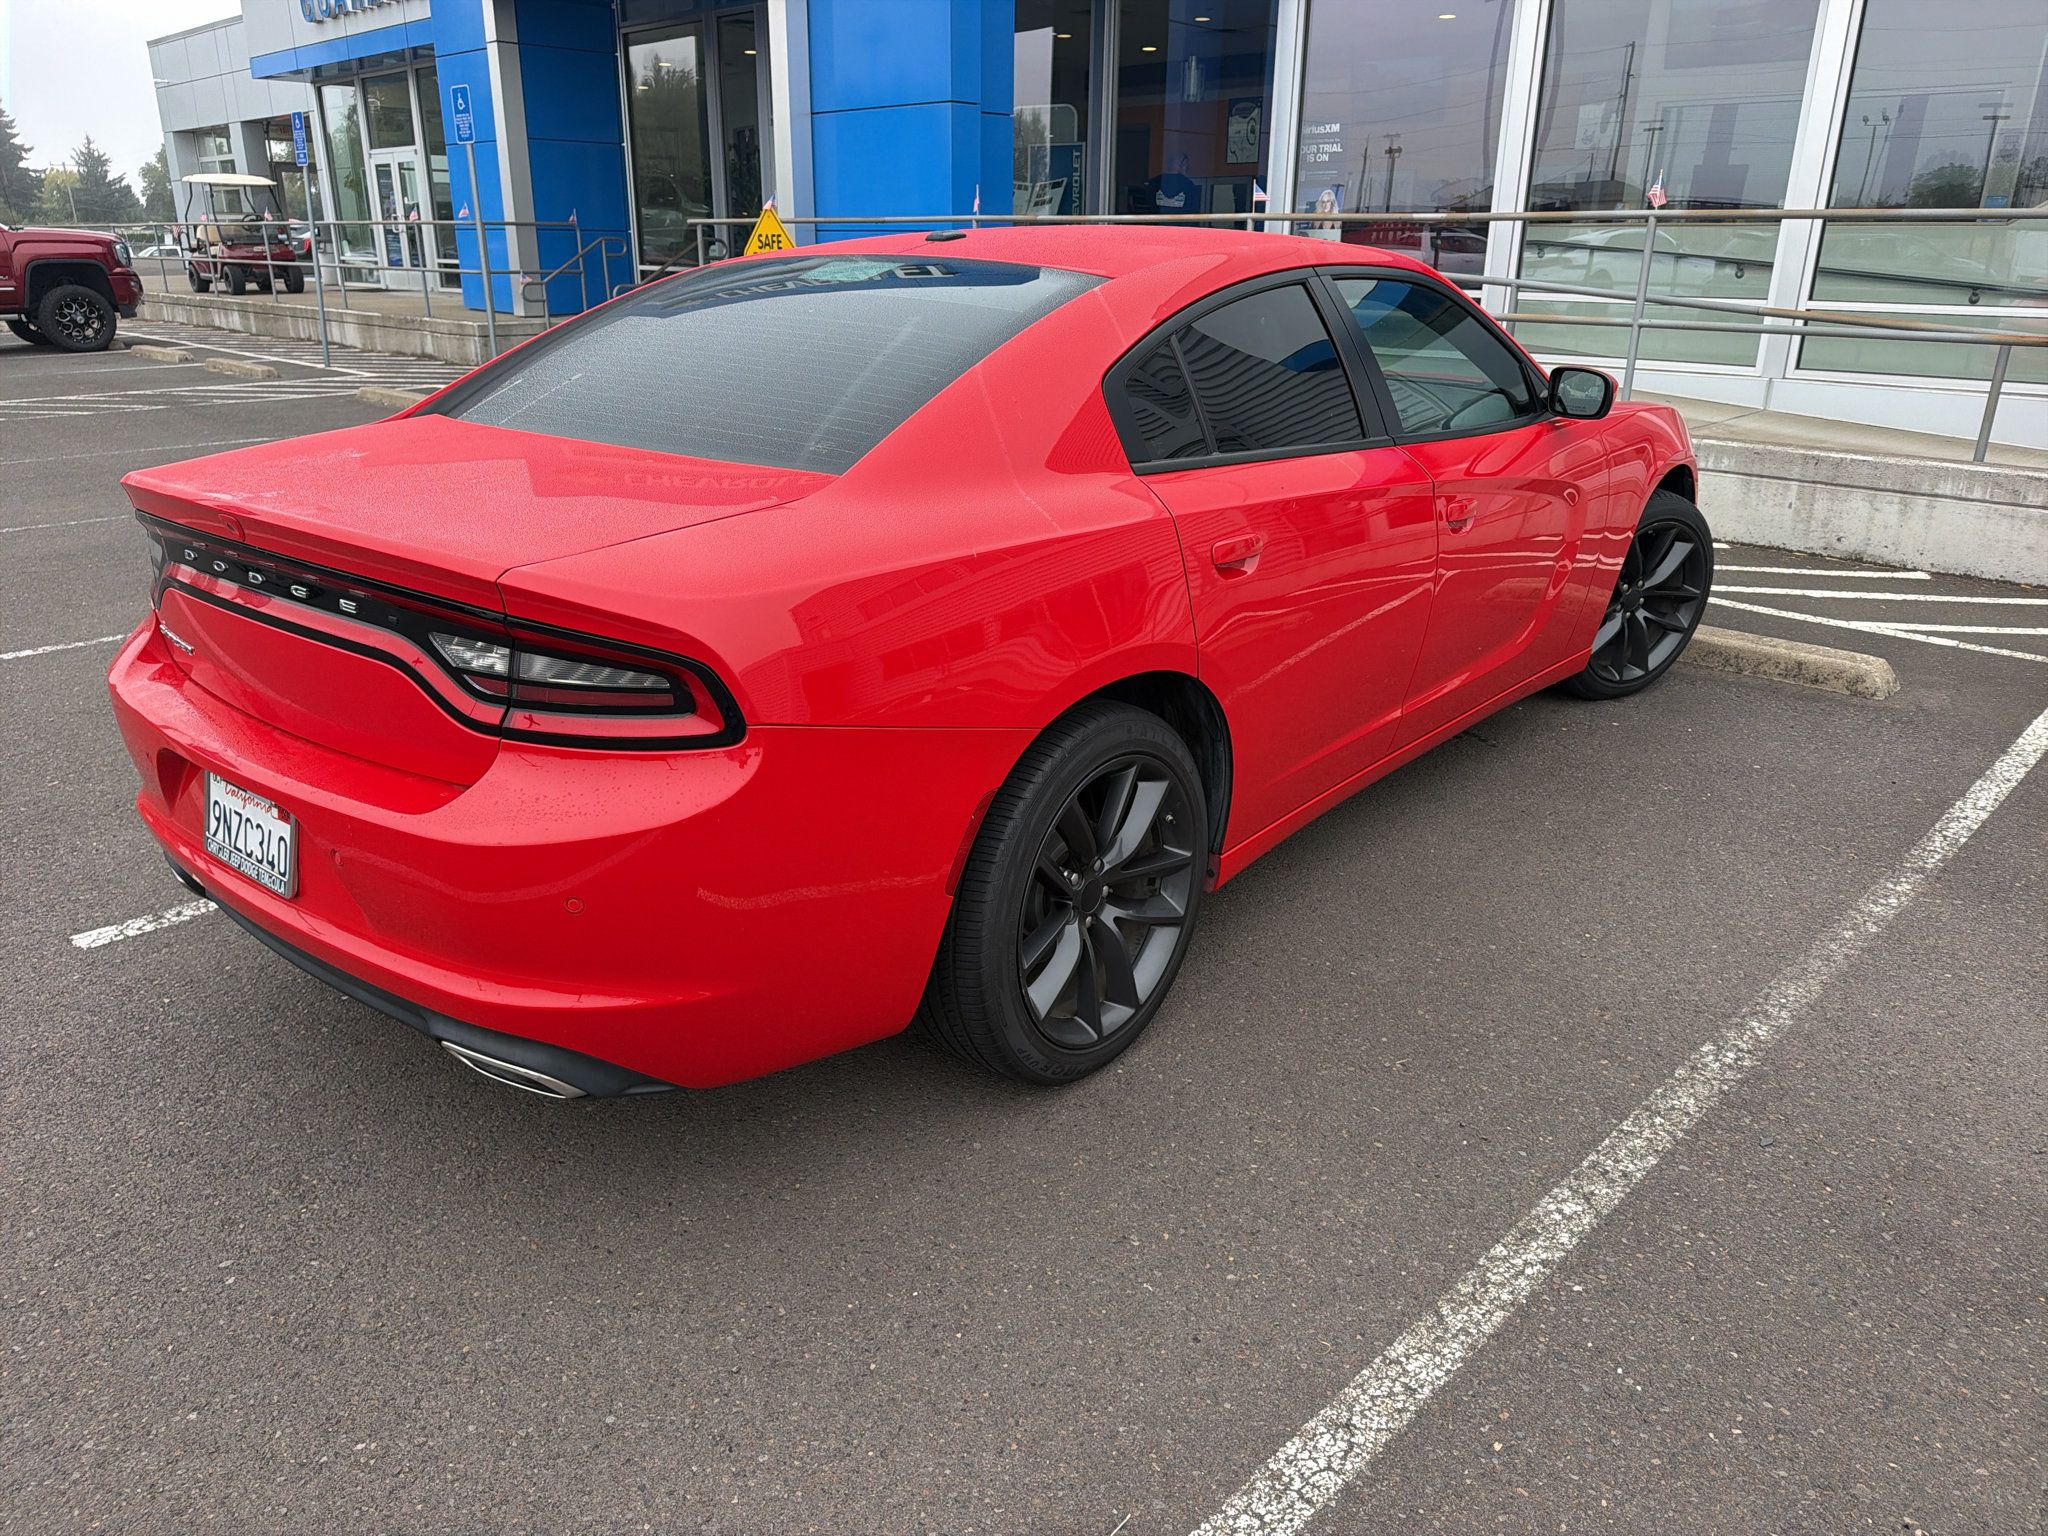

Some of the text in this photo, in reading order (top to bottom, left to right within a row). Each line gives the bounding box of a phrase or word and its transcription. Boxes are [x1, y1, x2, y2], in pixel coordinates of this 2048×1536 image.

[1302, 123, 1340, 134] iriusXM
[1301, 143, 1343, 154] OUR TRIAL
[1306, 153, 1329, 163] IS ON
[1072, 149, 1081, 215] EVROLET
[757, 233, 783, 250] SAFE
[184, 549, 357, 614] DODGE
[224, 782, 272, 814] California
[213, 799, 288, 878] 9NZC340
[240, 858, 259, 880] DODGE
